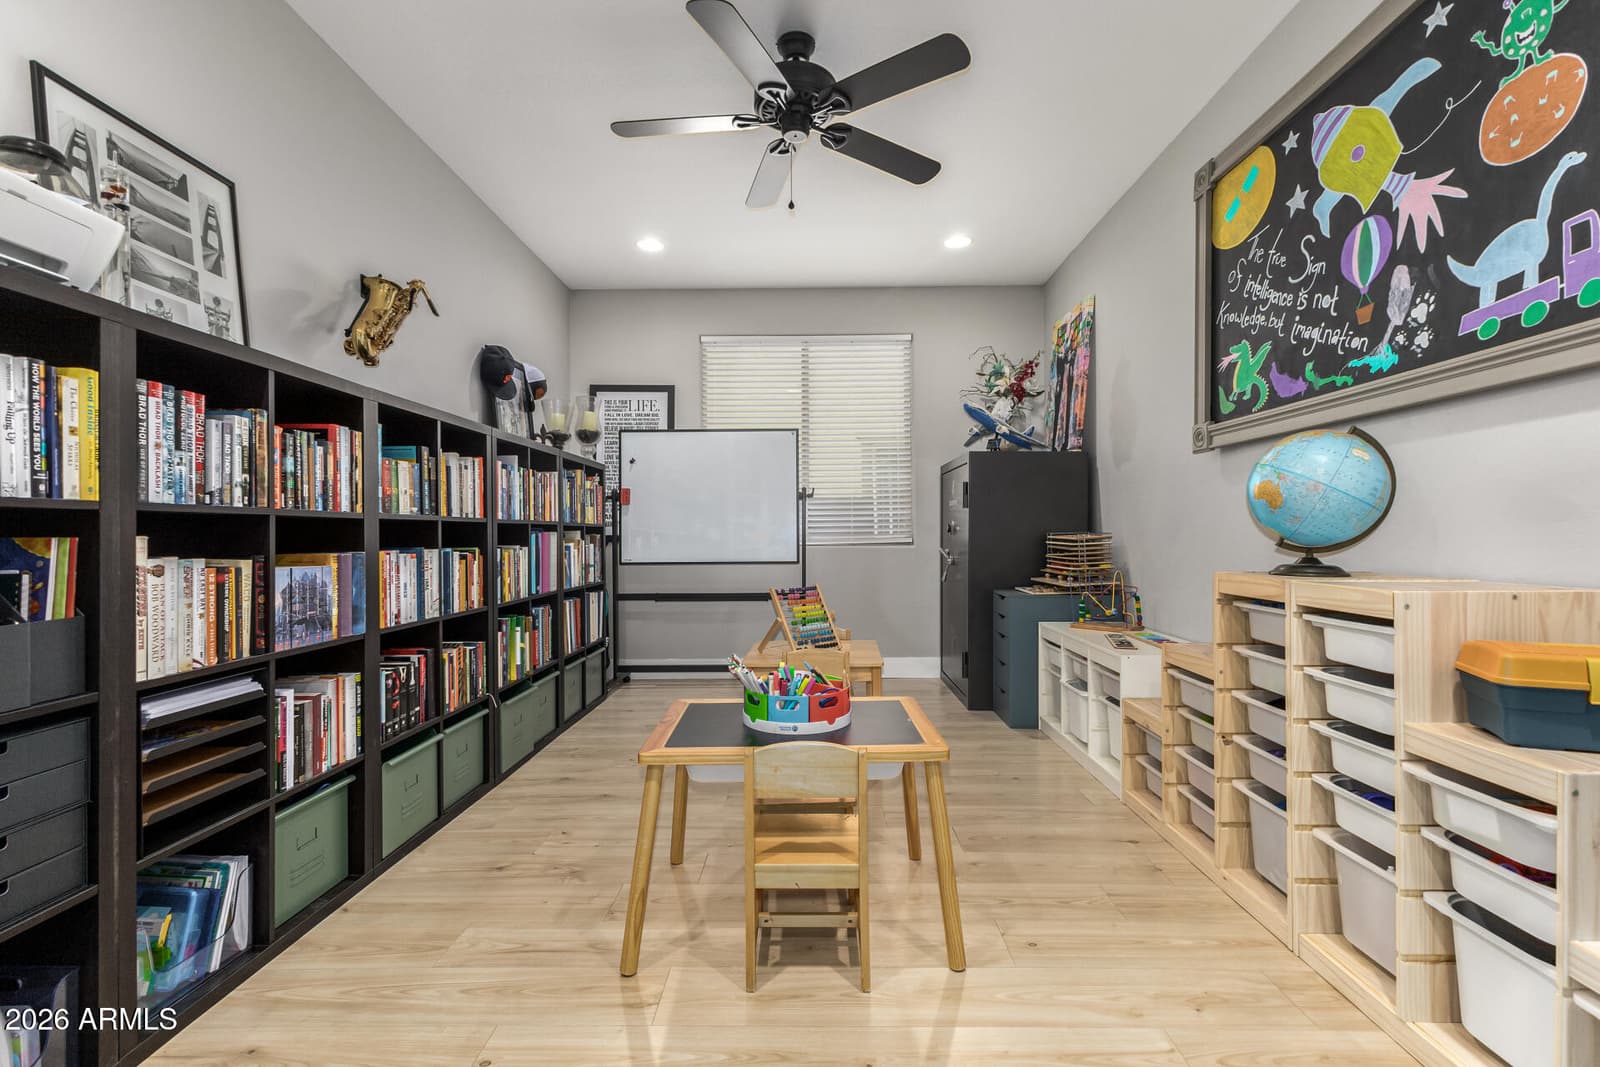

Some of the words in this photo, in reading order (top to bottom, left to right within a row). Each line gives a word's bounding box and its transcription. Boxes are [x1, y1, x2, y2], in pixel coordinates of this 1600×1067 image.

[1248, 224, 1270, 263] The
[1266, 228, 1286, 278] true
[1288, 234, 1326, 292] Sign
[1228, 258, 1246, 292] of
[1243, 274, 1294, 311] intelligence
[1297, 288, 1308, 310] is
[1312, 285, 1340, 316] not
[1268, 312, 1286, 336] but
[1290, 316, 1368, 356] imagination
[4, 400, 16, 430] Falling
[138, 395, 146, 421] BRAD
[629, 399, 660, 411] LIFE.
[6, 432, 16, 444] Up
[139, 422, 147, 445] THOR
[196, 413, 204, 438] BRAD
[196, 441, 204, 463] THOR
[209, 574, 215, 583] 12
[152, 605, 160, 662] WOODWARD
